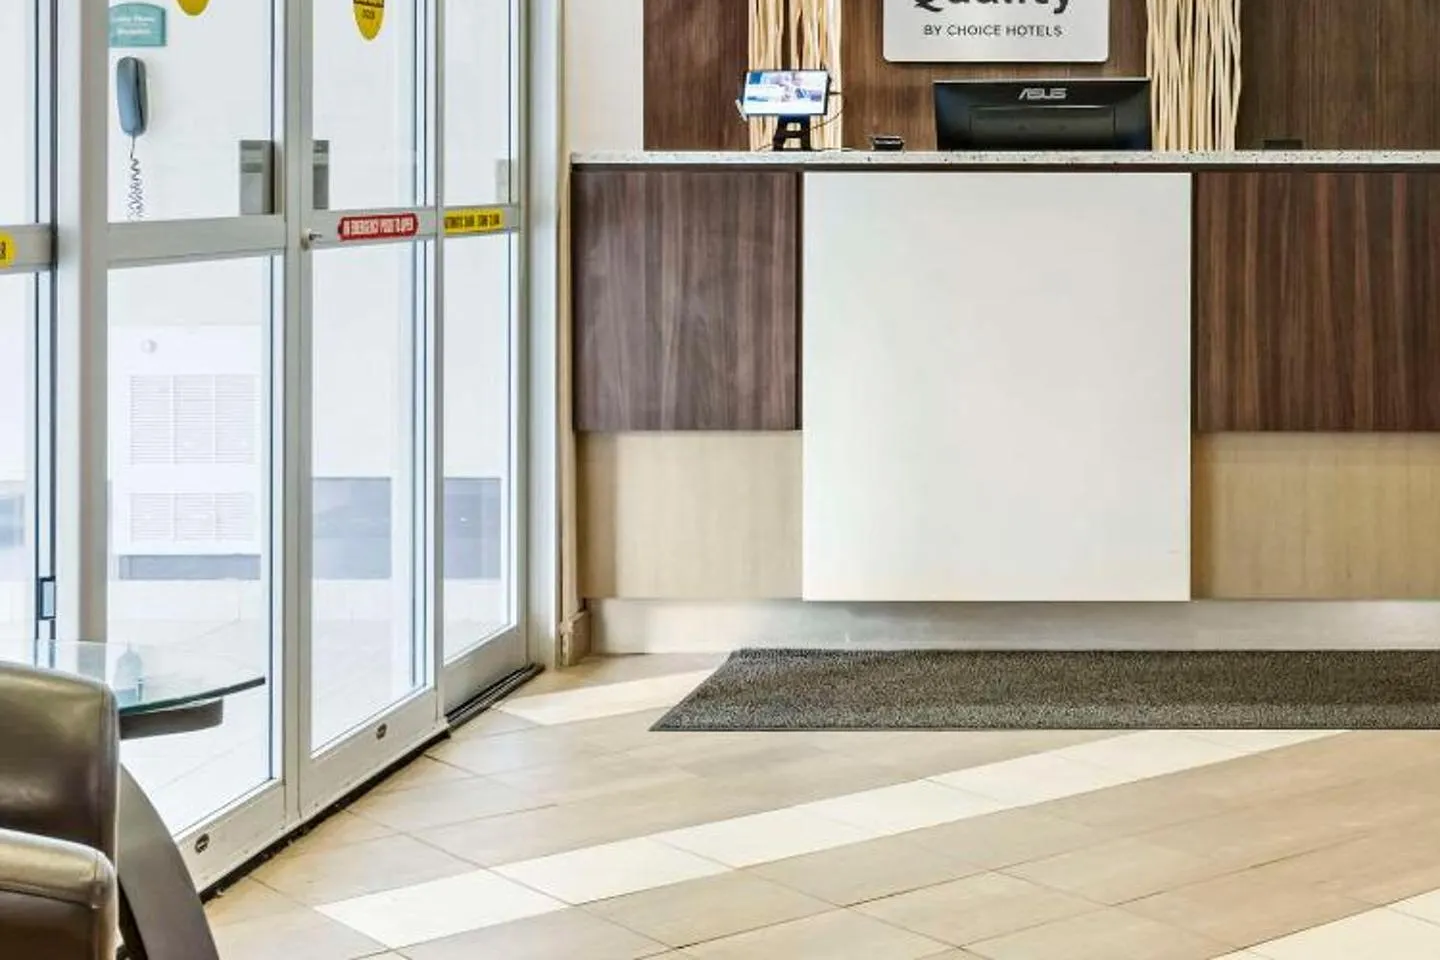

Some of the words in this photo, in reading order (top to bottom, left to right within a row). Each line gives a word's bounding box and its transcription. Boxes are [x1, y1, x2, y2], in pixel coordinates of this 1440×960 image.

[924, 24, 942, 36] BY
[947, 24, 1001, 37] CHOICE
[1006, 25, 1063, 37] HOTELS
[1018, 87, 1067, 100] ASUS
